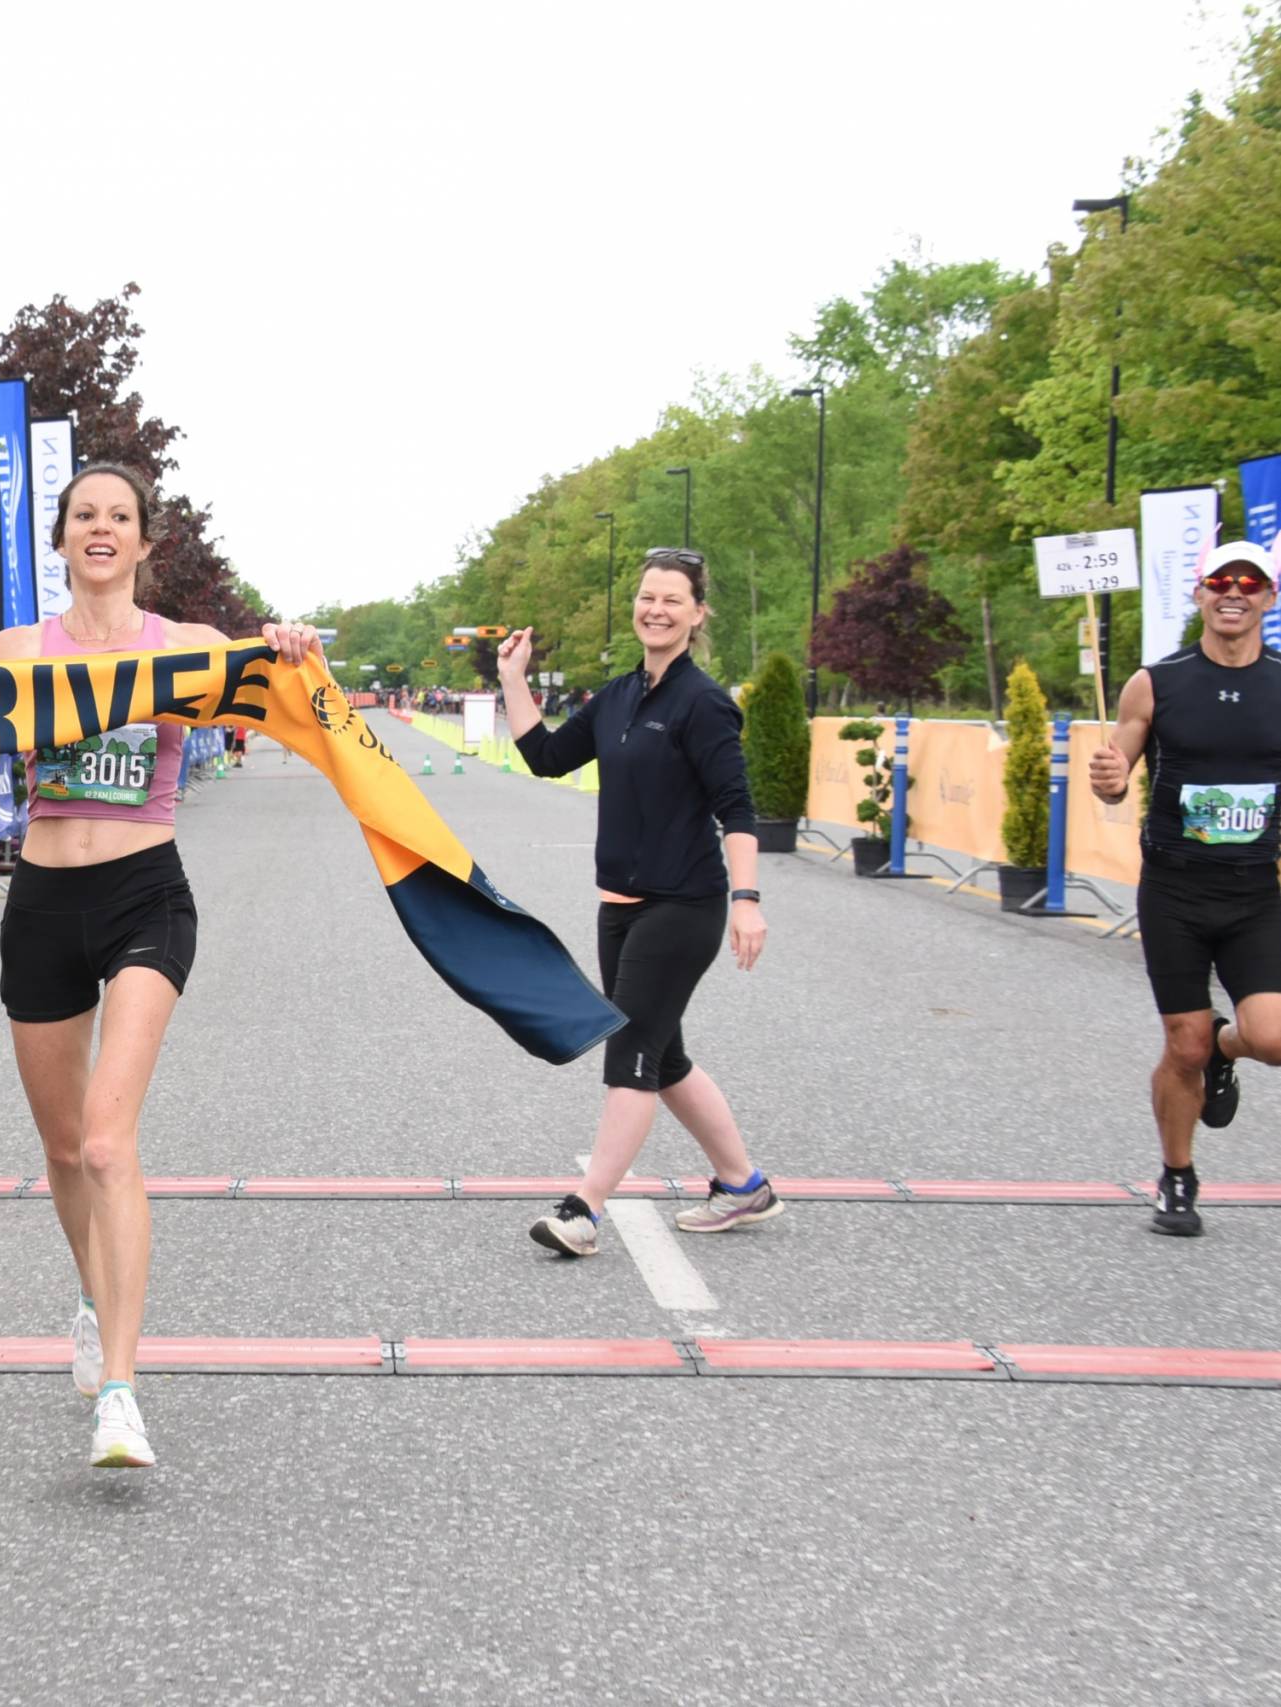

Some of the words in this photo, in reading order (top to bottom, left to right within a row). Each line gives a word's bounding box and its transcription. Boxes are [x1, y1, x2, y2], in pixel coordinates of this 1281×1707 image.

[1083, 552, 1118, 569] 2:59
[1087, 575, 1119, 591] 1:29
[80, 752, 146, 788] 3015
[1216, 806, 1266, 831] 3016
